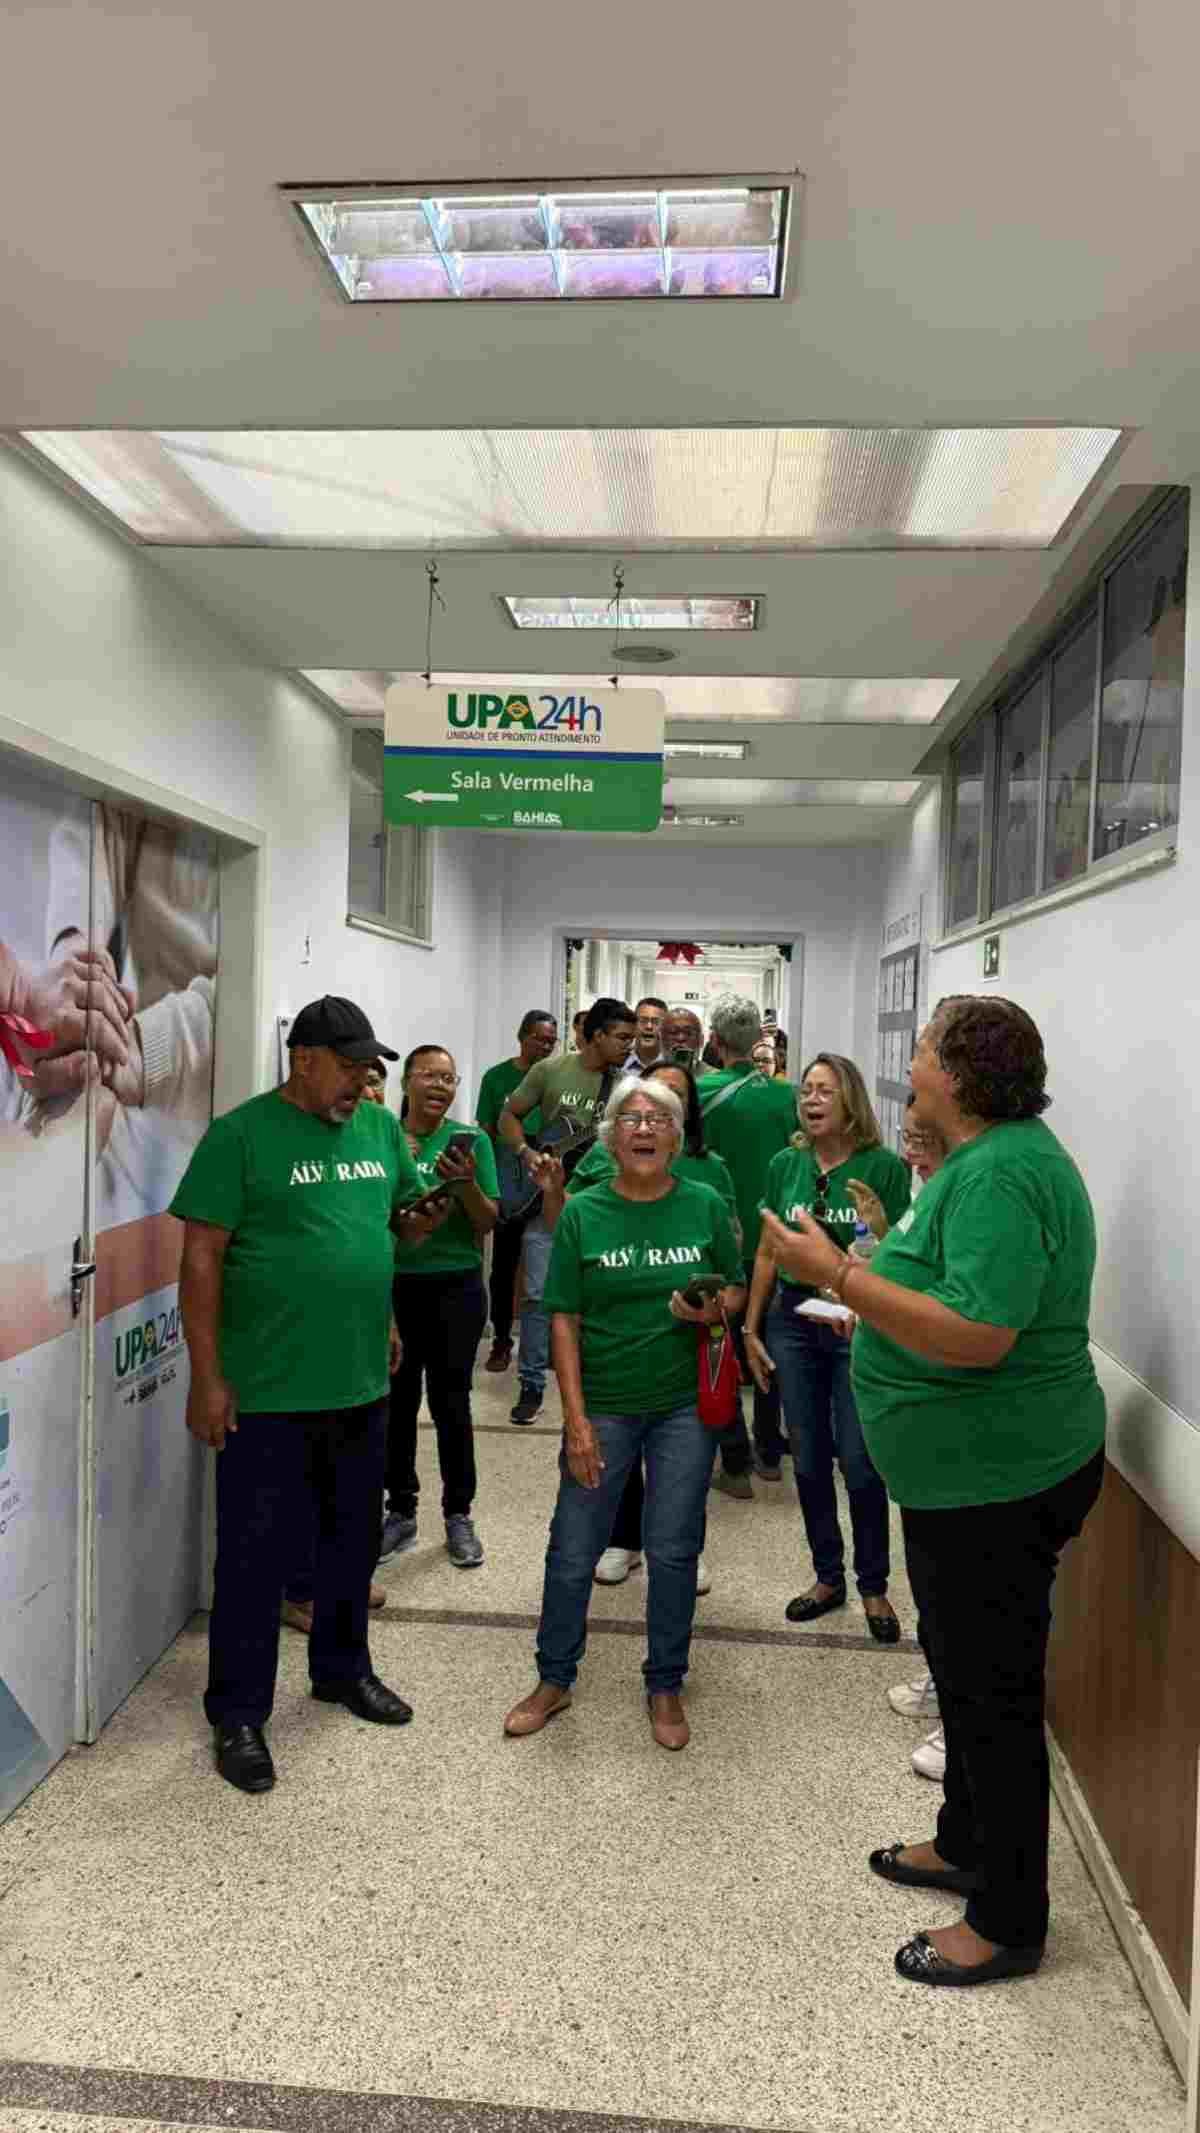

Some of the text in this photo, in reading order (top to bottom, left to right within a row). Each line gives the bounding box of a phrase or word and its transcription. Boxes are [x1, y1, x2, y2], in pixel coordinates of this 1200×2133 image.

[447, 730, 601, 744] UNIDADE DE PRONTO ATENDIMENTO
[450, 770, 594, 792] Sala Vermelha
